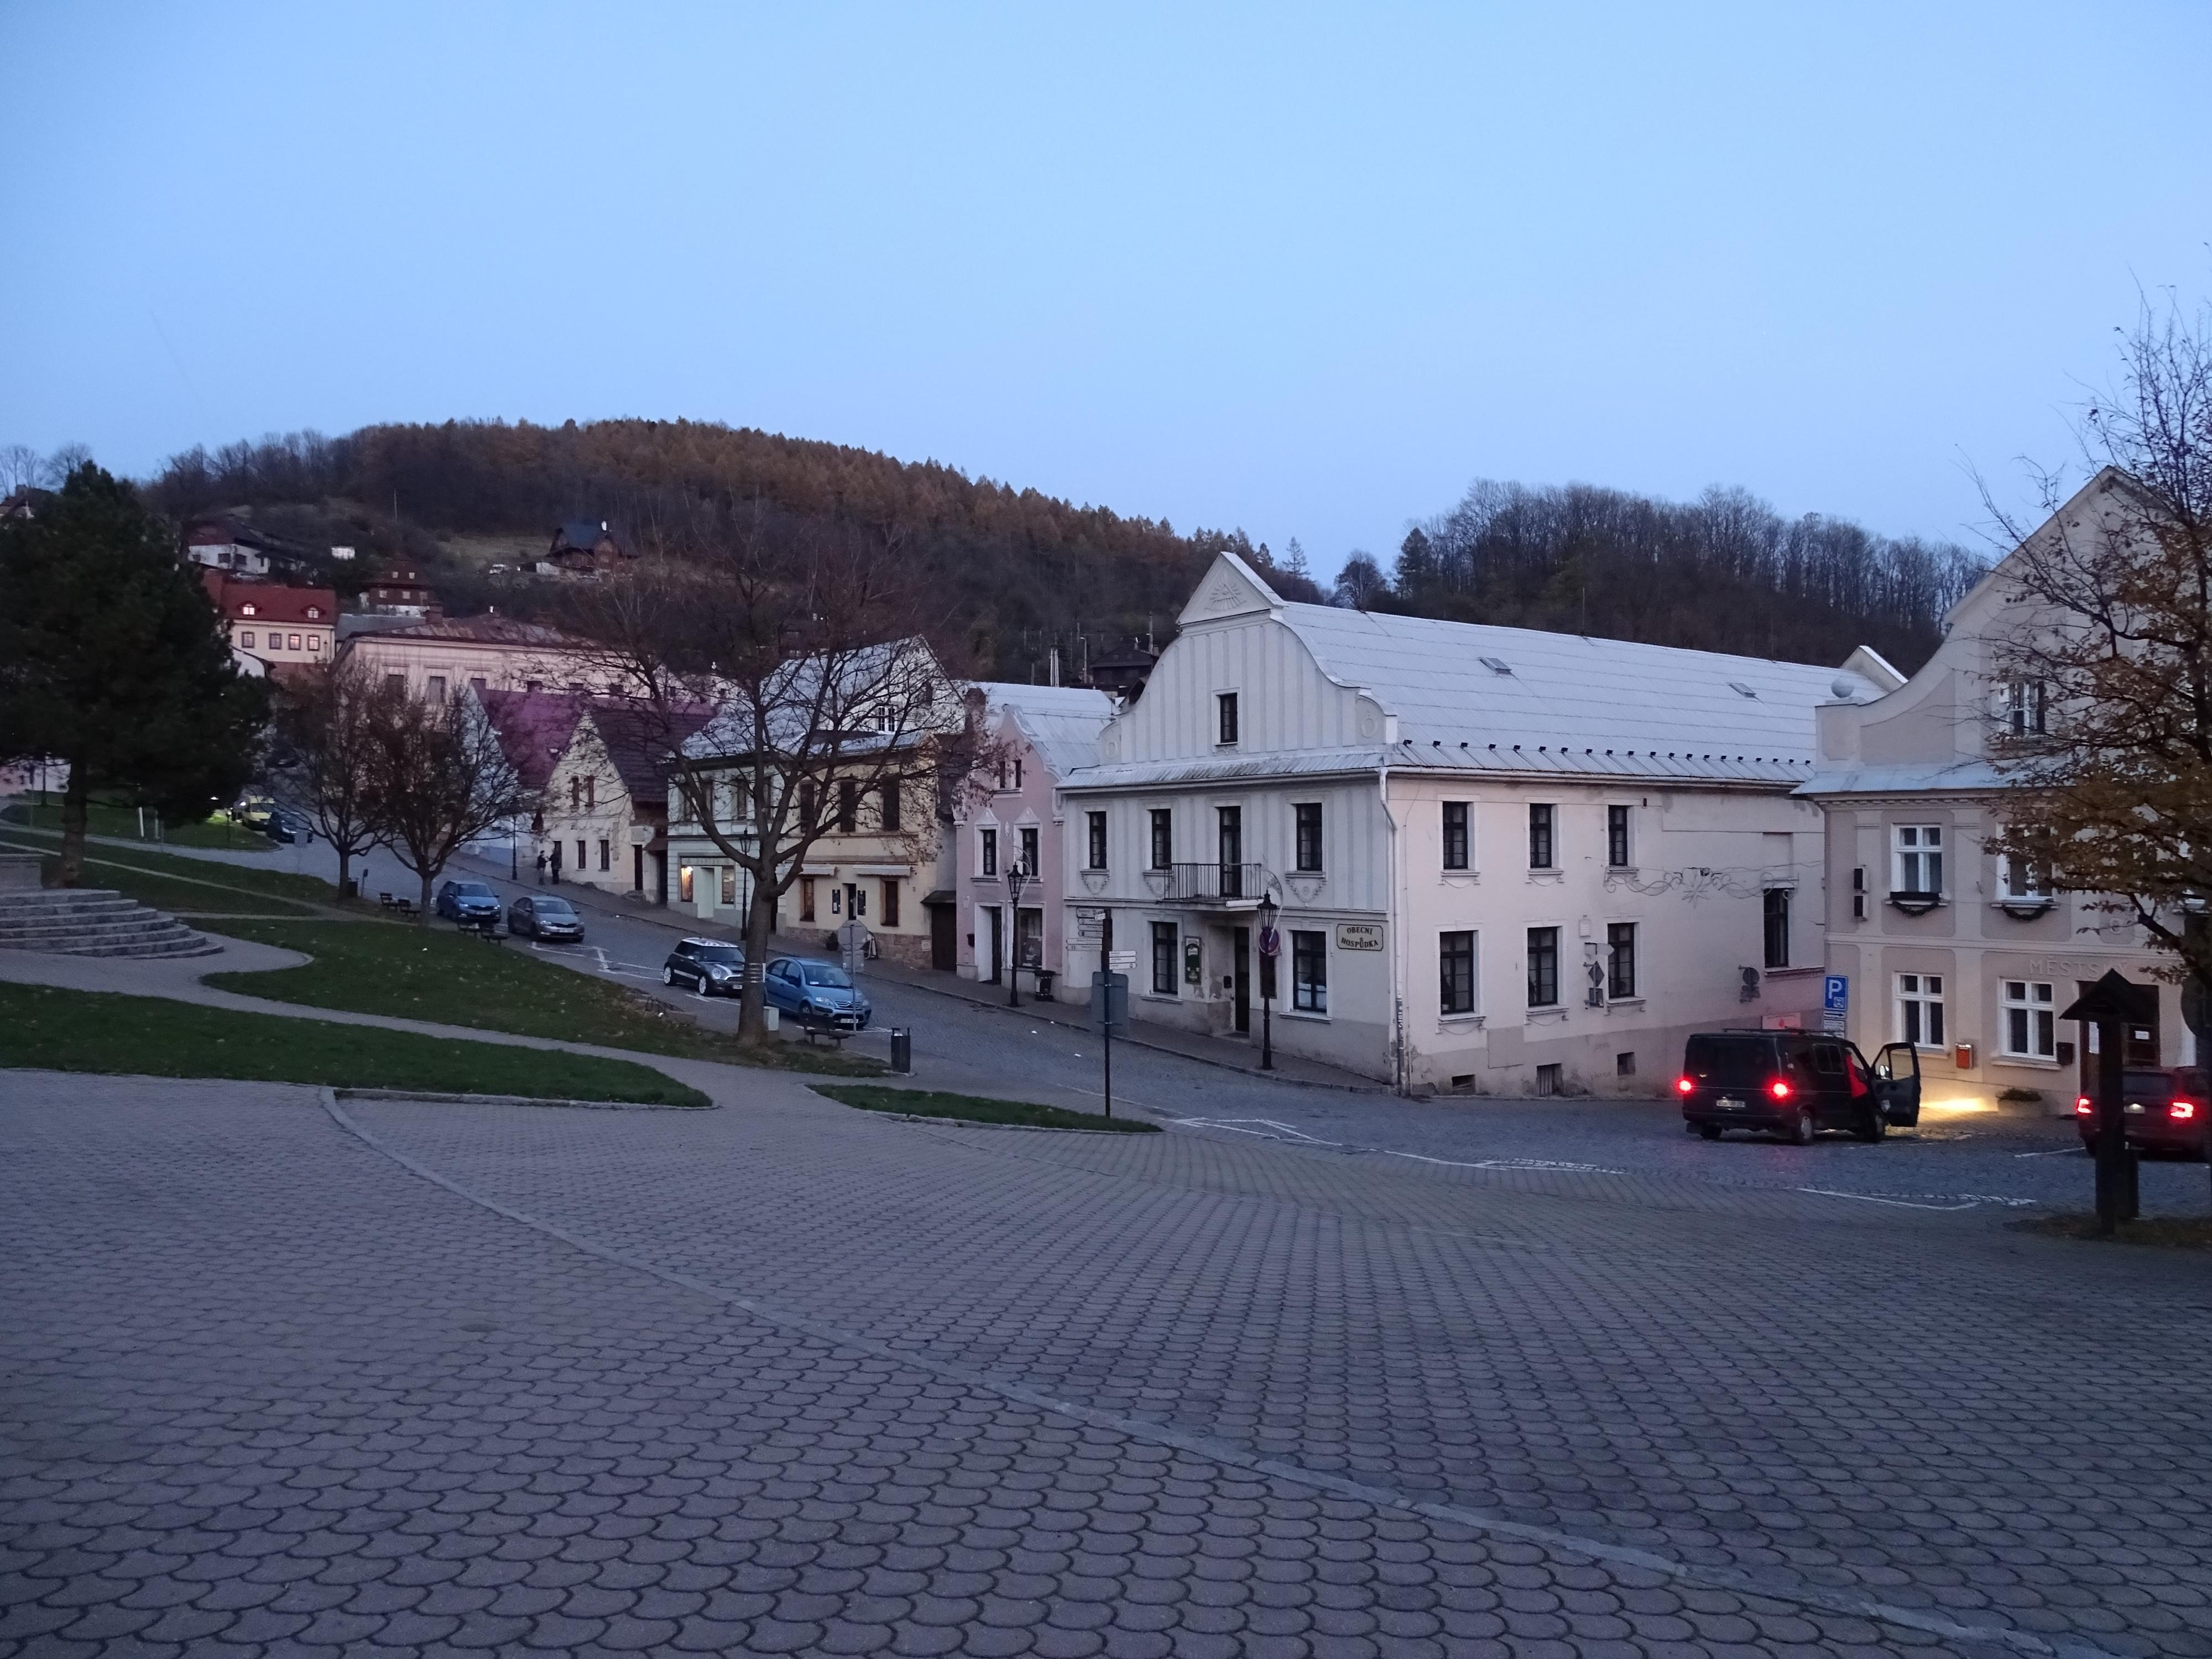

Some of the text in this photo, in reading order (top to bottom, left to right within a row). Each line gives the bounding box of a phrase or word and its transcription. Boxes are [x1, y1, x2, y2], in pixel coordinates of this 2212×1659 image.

[1347, 927, 1373, 935] OBECNÍ
[1341, 937, 1379, 948] HOSPŮDKA
[1828, 979, 1843, 999] P
